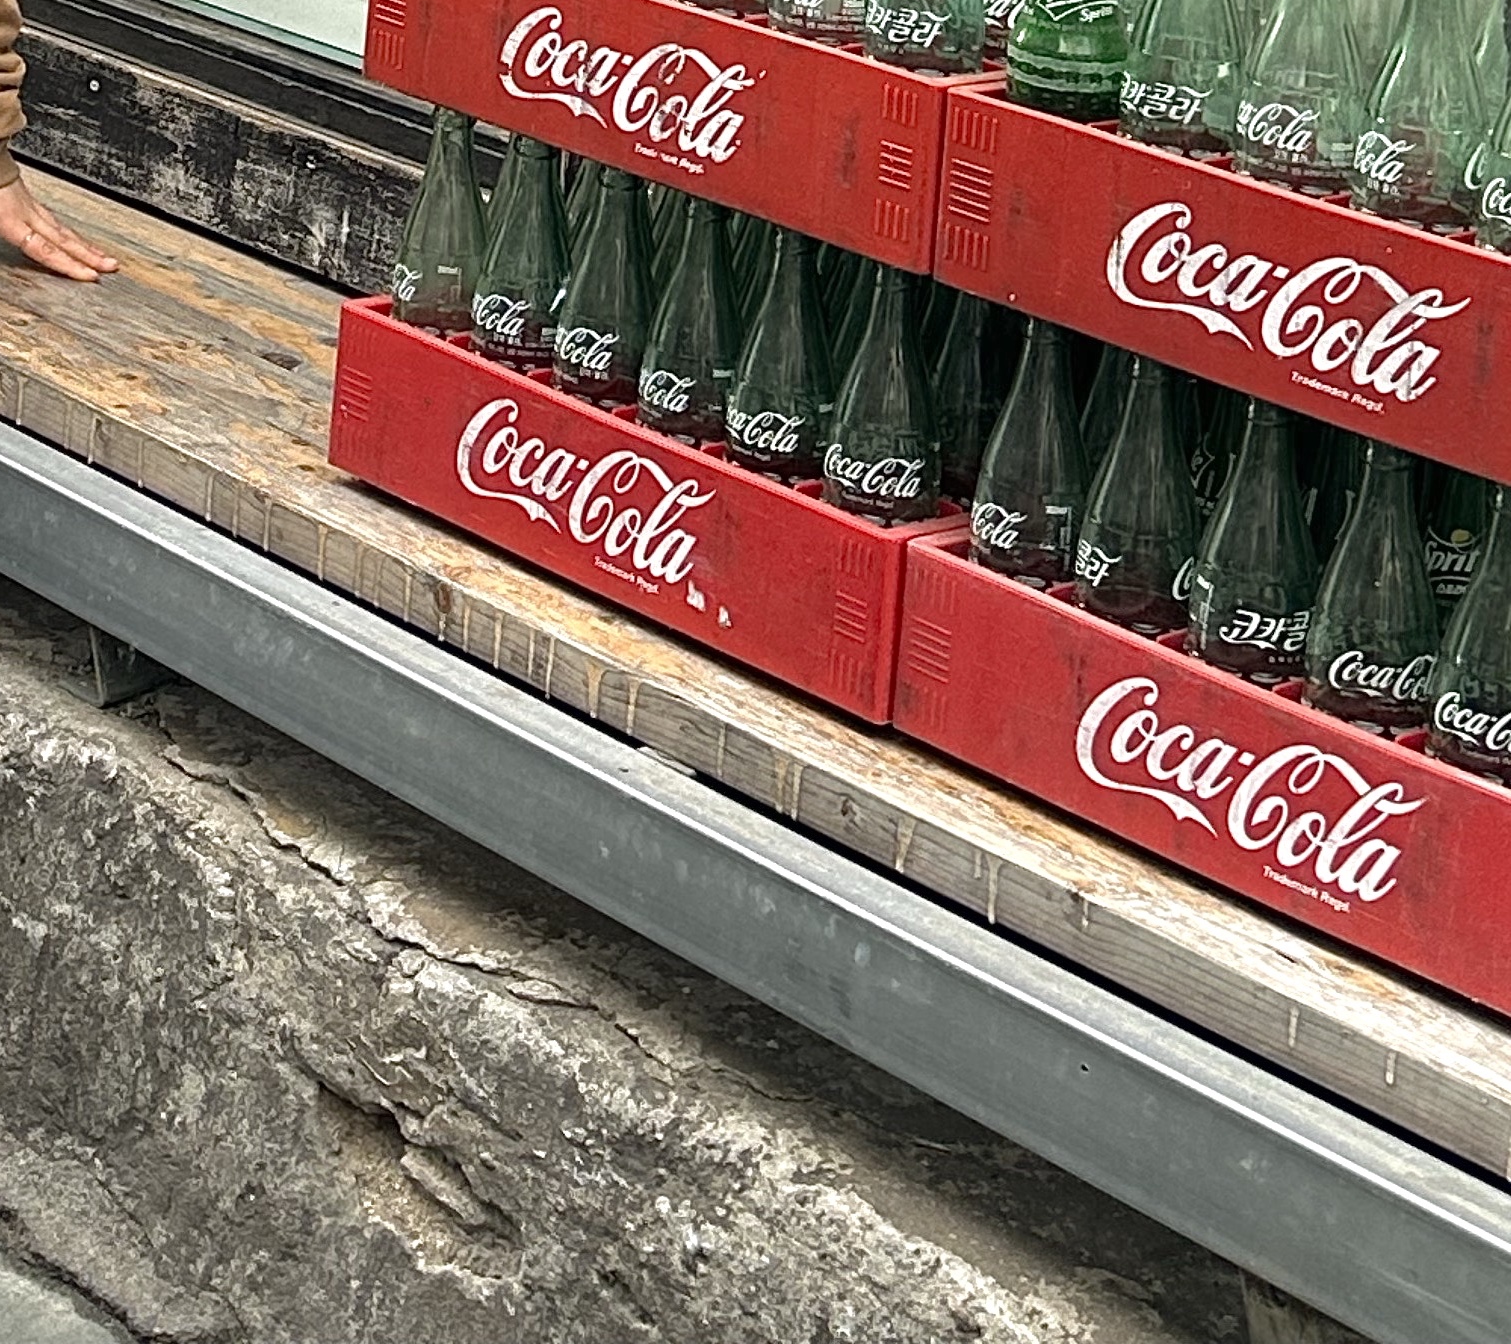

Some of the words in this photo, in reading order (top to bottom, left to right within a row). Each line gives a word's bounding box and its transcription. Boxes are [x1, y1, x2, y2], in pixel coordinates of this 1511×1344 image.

[498, 7, 758, 165] Coca-Cola
[1105, 201, 1472, 404] Coca-Cola
[456, 398, 717, 585] Coca-Cola
[824, 443, 926, 499] Coca-Cola
[1075, 676, 1431, 904] Coca-Cola
